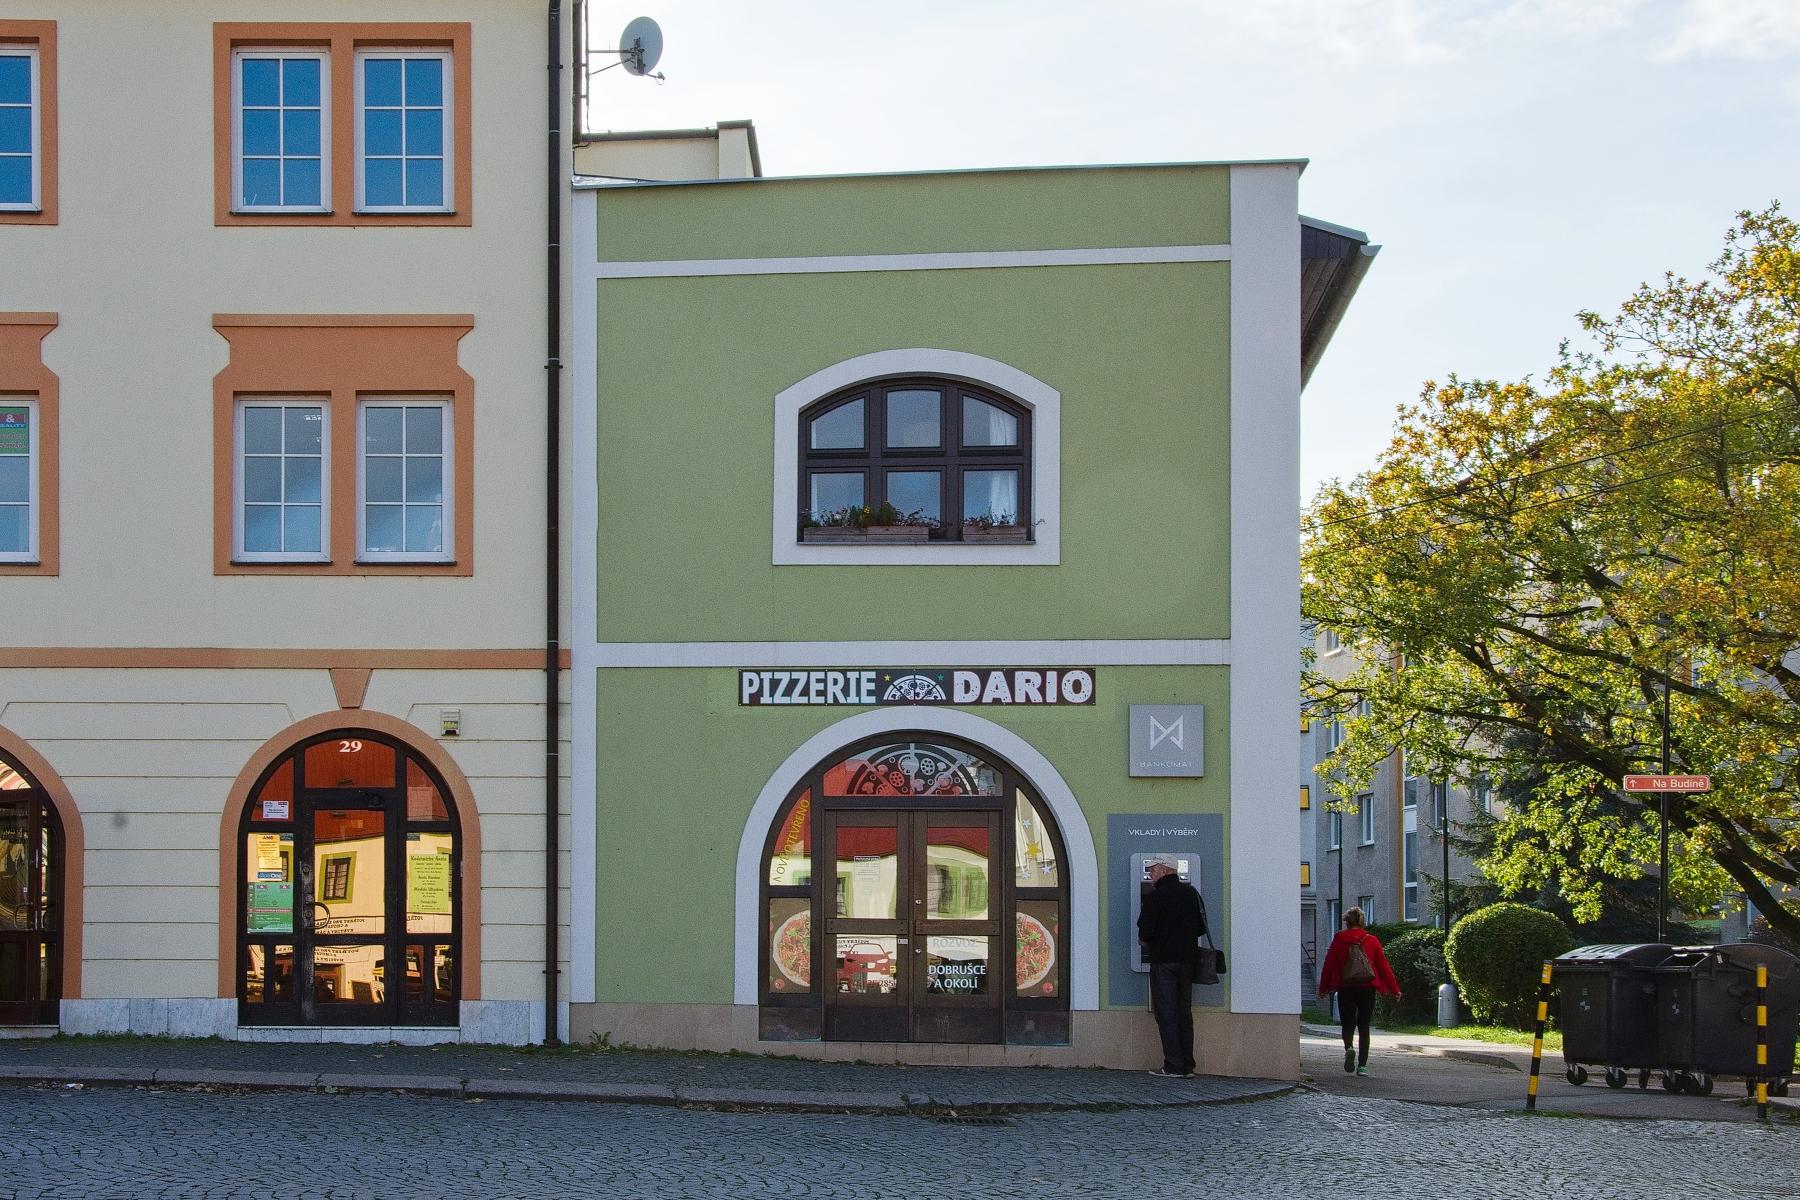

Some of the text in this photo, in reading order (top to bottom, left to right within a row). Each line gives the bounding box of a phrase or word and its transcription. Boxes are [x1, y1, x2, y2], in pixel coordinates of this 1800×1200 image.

[742, 670, 1093, 704] PIZZERIE DARIO
[339, 740, 362, 752] 29
[1653, 779, 1667, 788] Na
[928, 963, 986, 975] DOBRUŠCE
[934, 977, 978, 988] A OKOLÍ
